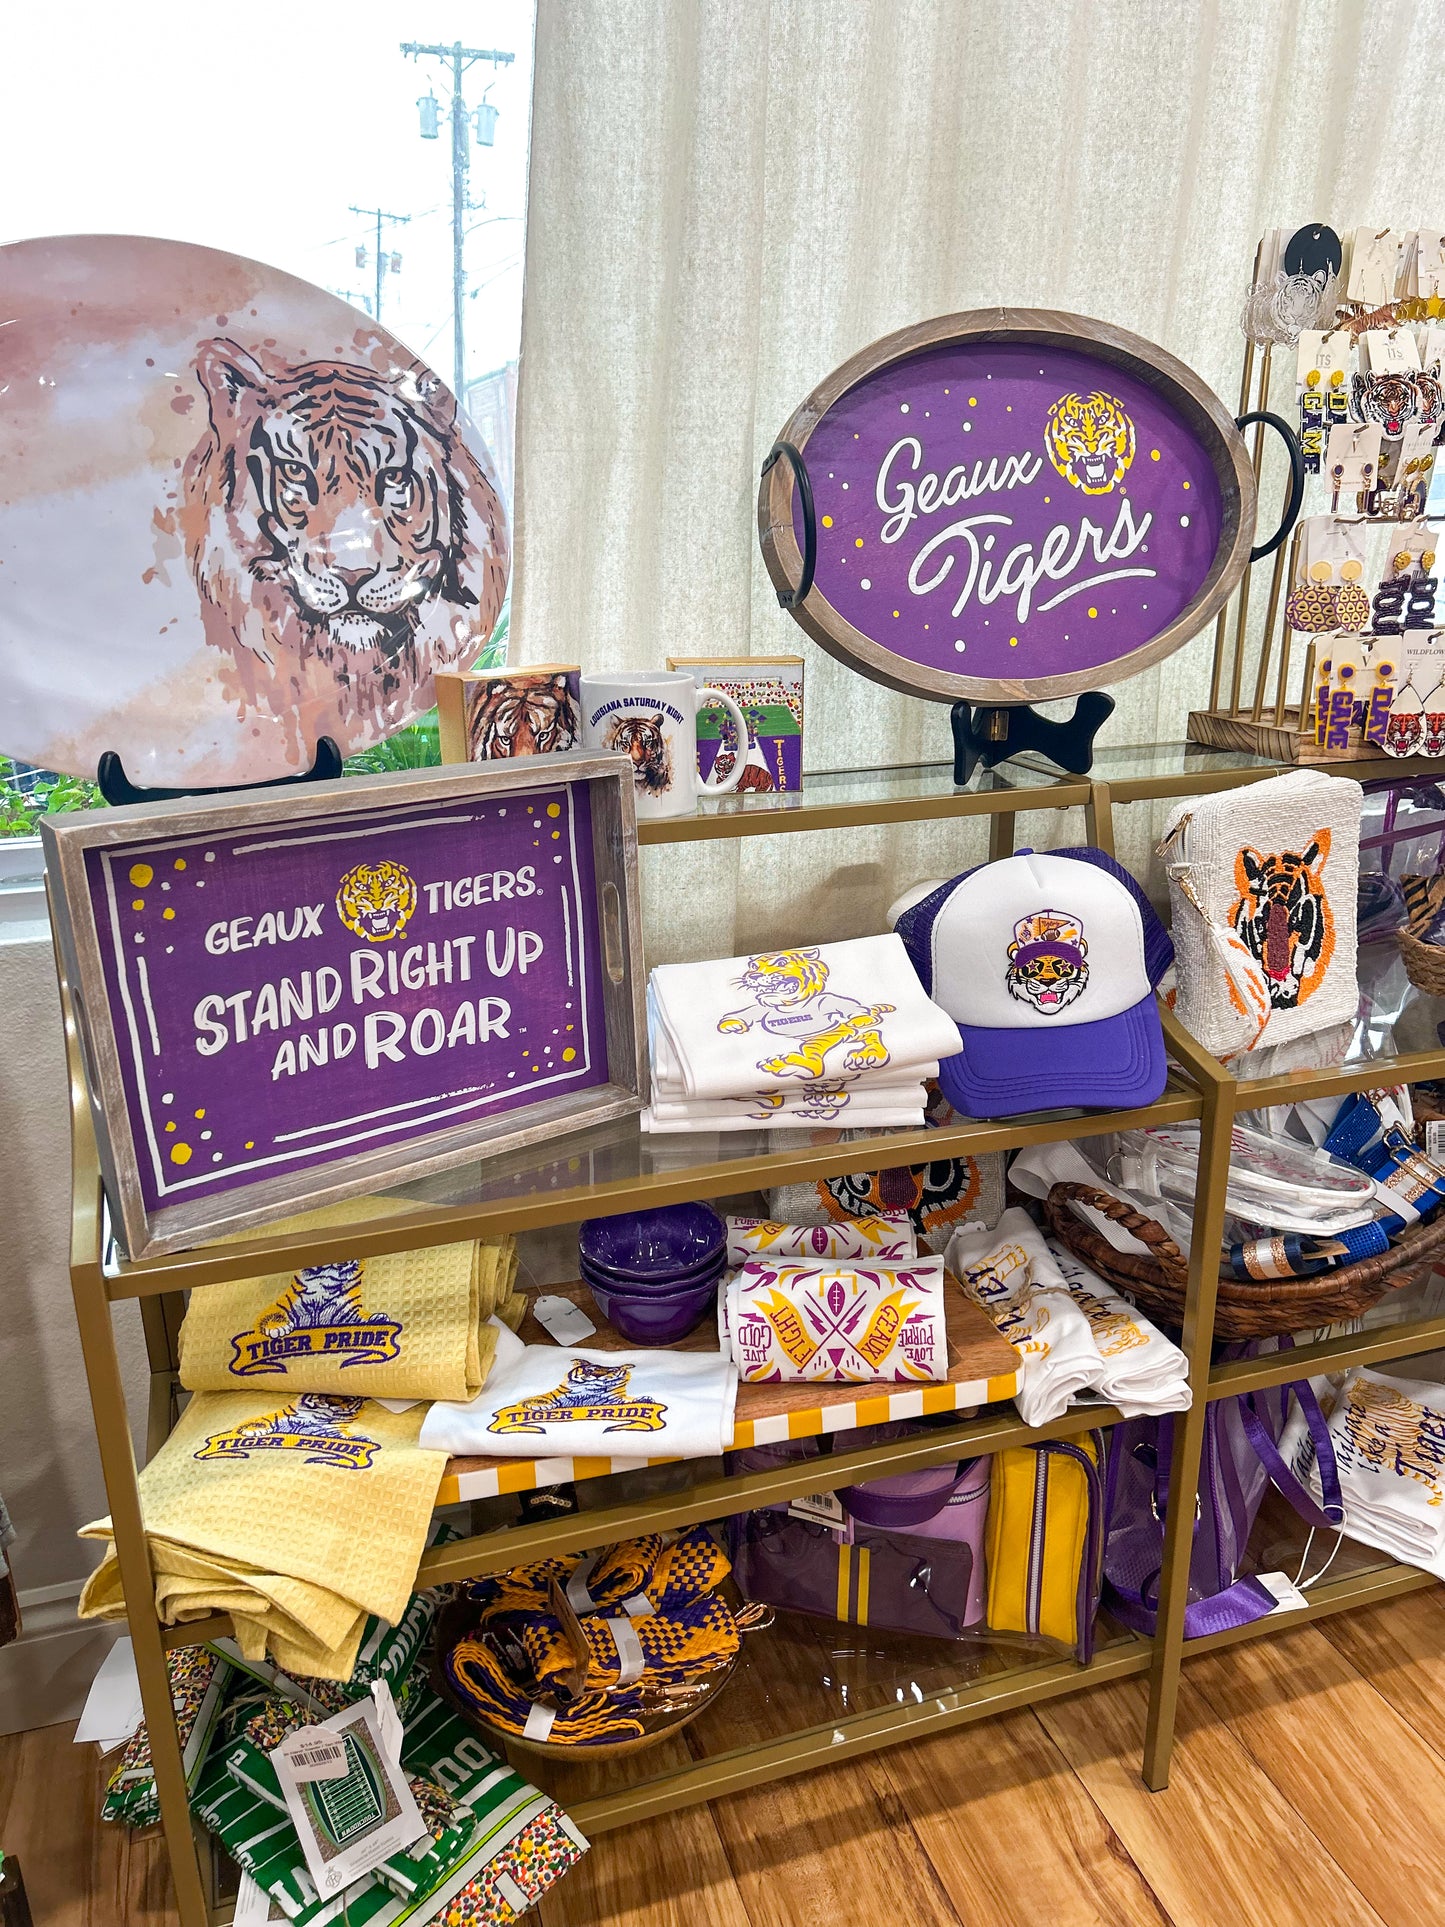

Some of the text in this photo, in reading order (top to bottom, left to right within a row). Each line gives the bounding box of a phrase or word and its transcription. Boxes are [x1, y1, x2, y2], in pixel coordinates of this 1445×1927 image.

[1315, 354, 1331, 366] ITS
[876, 437, 1043, 544] Geaux
[908, 497, 1152, 623] Tigers
[589, 697, 685, 728] LOUISIANA SATURDAY NIGHT
[1327, 691, 1354, 750] GAME
[1366, 687, 1394, 746] DAY
[204, 865, 538, 955] GEAUX TIGERS
[194, 931, 544, 1056] STAND RIGHT UP
[768, 1014, 813, 1028] TIGERS
[272, 1026, 357, 1080] AND
[364, 997, 511, 1070] ROAR
[247, 1329, 390, 1361] TIGER PRIDE
[738, 1323, 772, 1349] GOLD
[769, 1305, 813, 1364] FIGHT
[860, 1304, 899, 1361] GEAUX
[898, 1324, 936, 1347] PURPLE
[743, 1349, 767, 1362] LIVE
[906, 1347, 934, 1362] LOVE
[506, 1407, 655, 1423] TIGER PRIDE
[217, 1436, 368, 1457] TIGER PRIDE
